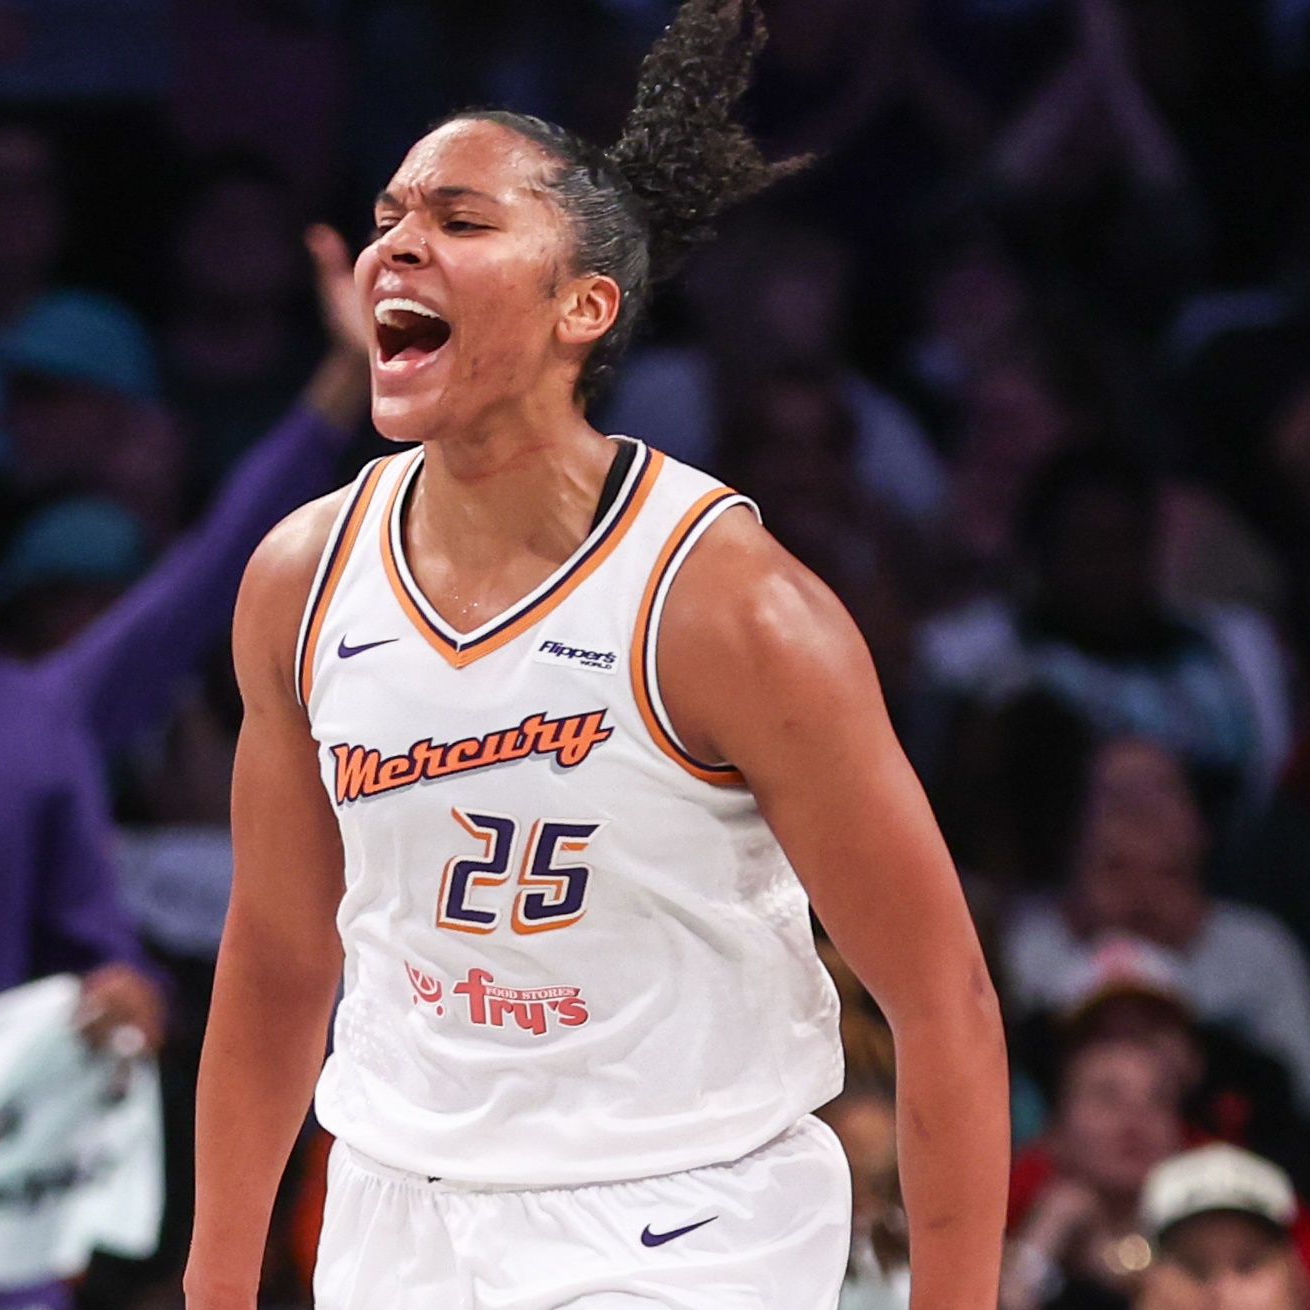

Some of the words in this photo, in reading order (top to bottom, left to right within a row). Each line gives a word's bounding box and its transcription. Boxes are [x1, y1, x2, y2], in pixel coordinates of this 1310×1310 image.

[330, 708, 615, 806] Mercury
[436, 805, 609, 936] 25
[453, 967, 589, 1036] fry's
[486, 985, 518, 1000] FOOD
[521, 987, 576, 1000] STORES
